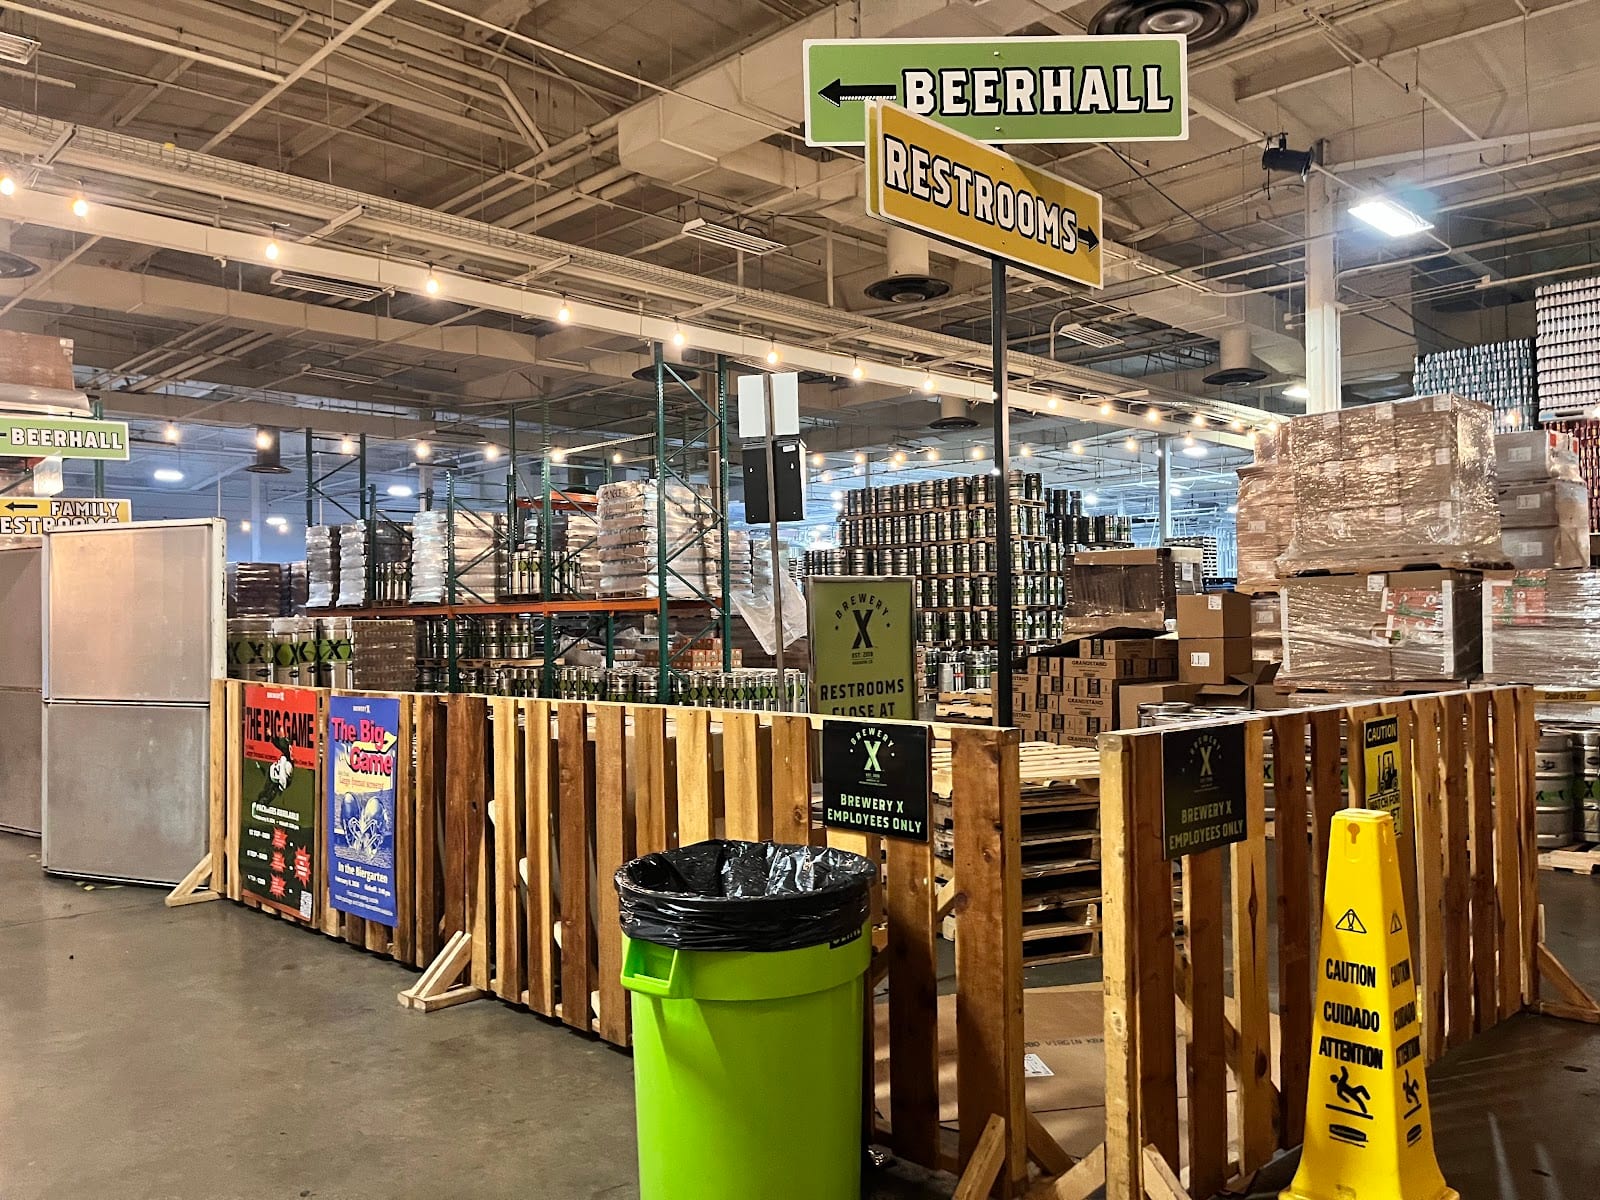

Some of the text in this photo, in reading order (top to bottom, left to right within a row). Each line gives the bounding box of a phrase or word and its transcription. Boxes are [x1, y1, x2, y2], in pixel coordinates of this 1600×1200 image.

[902, 64, 1173, 117] BEERHALL
[884, 135, 1077, 254] RESTROOMS
[10, 427, 123, 450] BEERHALL
[50, 501, 119, 517] FAMILY
[835, 593, 889, 620] BREWERY
[852, 609, 873, 650] X
[820, 679, 904, 701] RESTROOMS
[880, 702, 895, 717] AT
[246, 707, 314, 749] THE BIG GAME
[331, 717, 385, 750] The Big
[850, 727, 895, 748] BREWERY
[1367, 723, 1397, 742] CAUTION
[350, 746, 392, 775] Game
[863, 740, 882, 771] X
[1200, 745, 1212, 777] X
[840, 793, 904, 814] BREWERY X
[1181, 799, 1232, 824] BREWERY X
[827, 807, 922, 834] EMPLOYEES ONLY
[1169, 819, 1244, 850] EMPLOYEES ONLY
[1325, 958, 1376, 988] CAUTION
[1323, 1000, 1380, 1033] CUIDADO
[1319, 1035, 1383, 1070] ATTENTION
